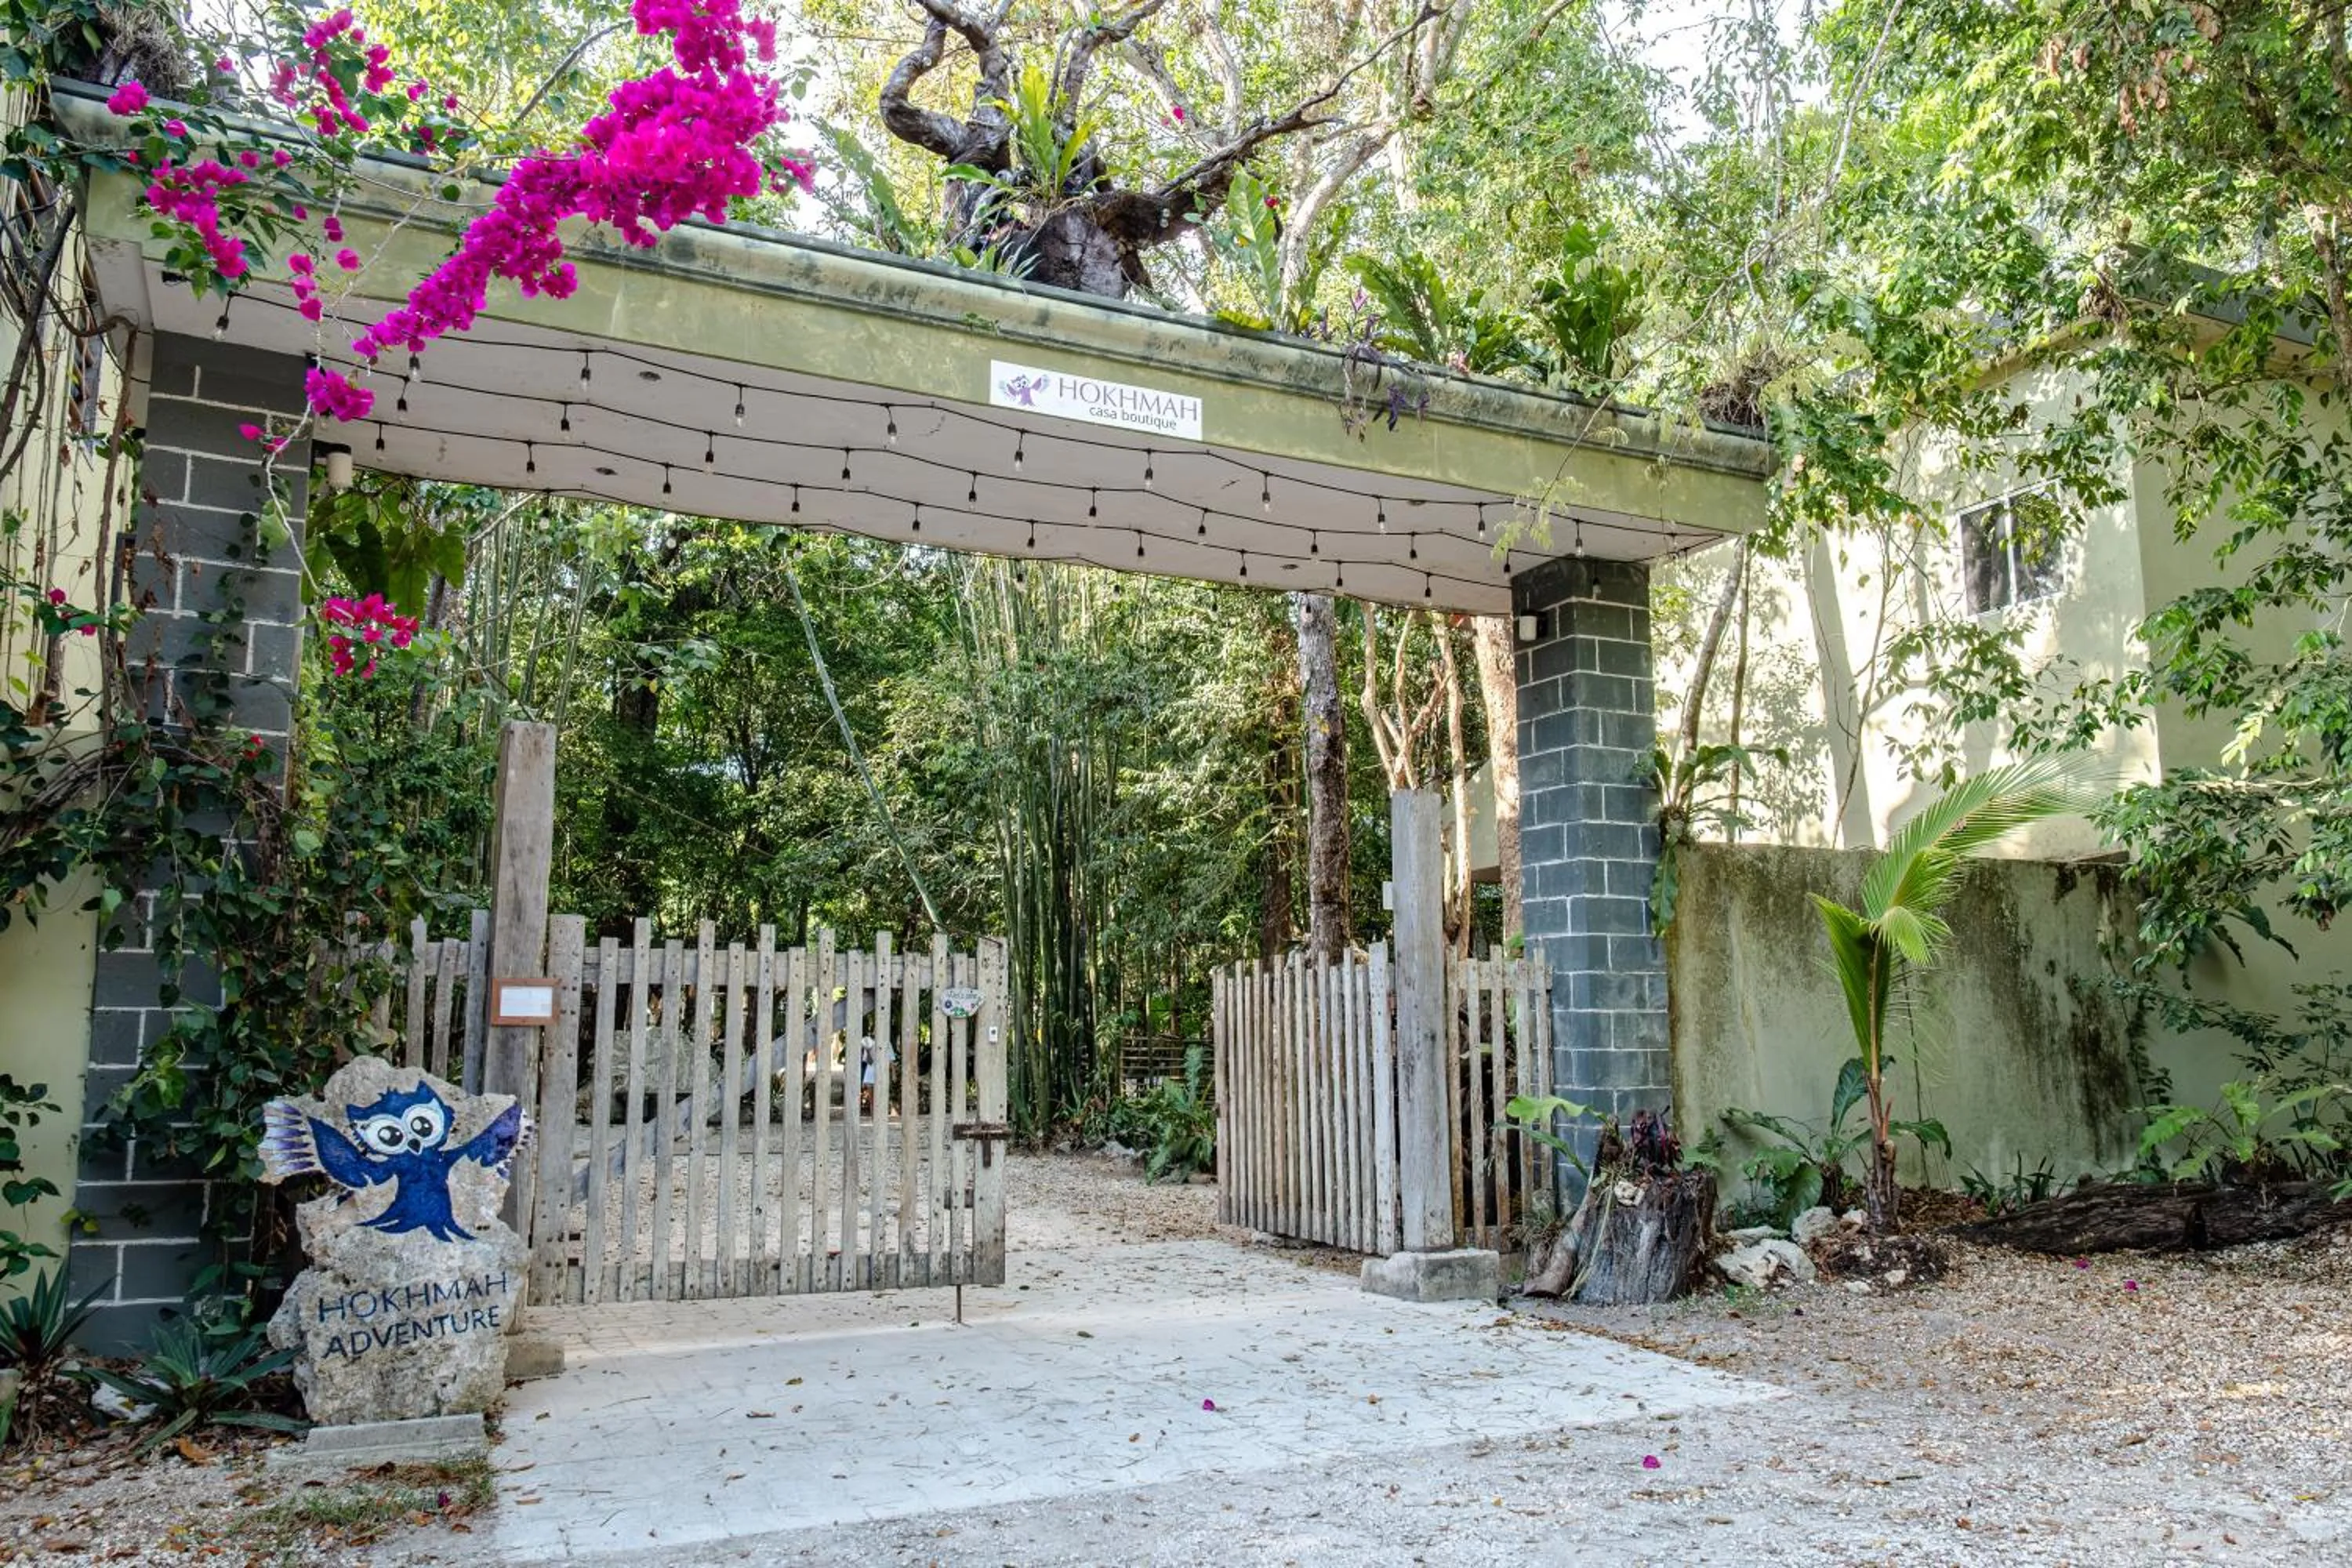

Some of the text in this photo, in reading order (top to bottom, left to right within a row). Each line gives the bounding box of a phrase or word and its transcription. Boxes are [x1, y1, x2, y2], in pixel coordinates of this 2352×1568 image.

[1059, 377, 1197, 421] HOKHMAH
[1089, 406, 1177, 430] casa boutique
[318, 1271, 506, 1323] HOKHMAH
[321, 1305, 500, 1359] ADVENTURE
